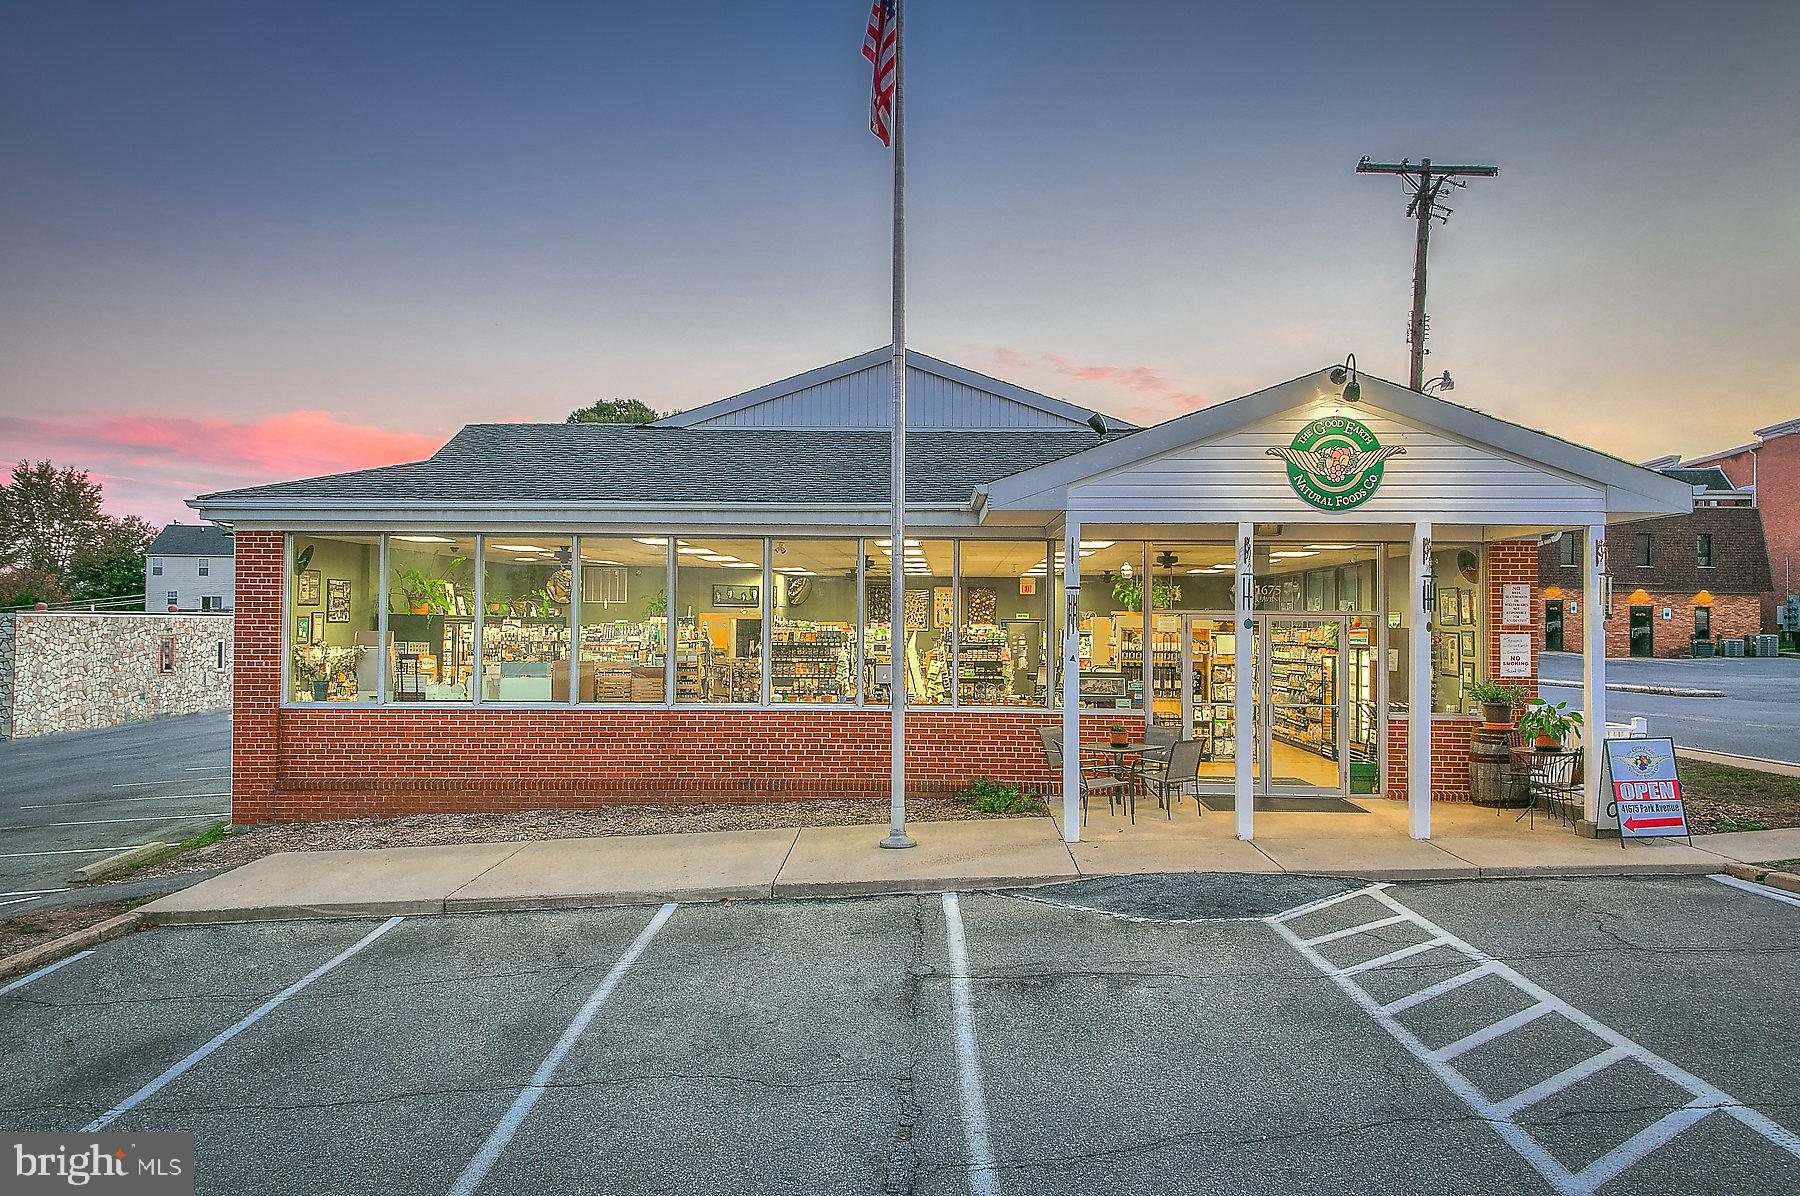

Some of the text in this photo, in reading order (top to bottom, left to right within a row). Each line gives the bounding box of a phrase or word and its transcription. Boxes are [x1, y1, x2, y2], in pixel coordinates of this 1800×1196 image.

[1298, 420, 1374, 445] THE GOOD EARTH
[1293, 474, 1334, 507] NATURAL
[1335, 489, 1367, 507] FOODS
[1255, 585, 1282, 596] 1675
[1620, 782, 1676, 801] OPEN
[1621, 803, 1680, 814] 41675 Park Avenue
